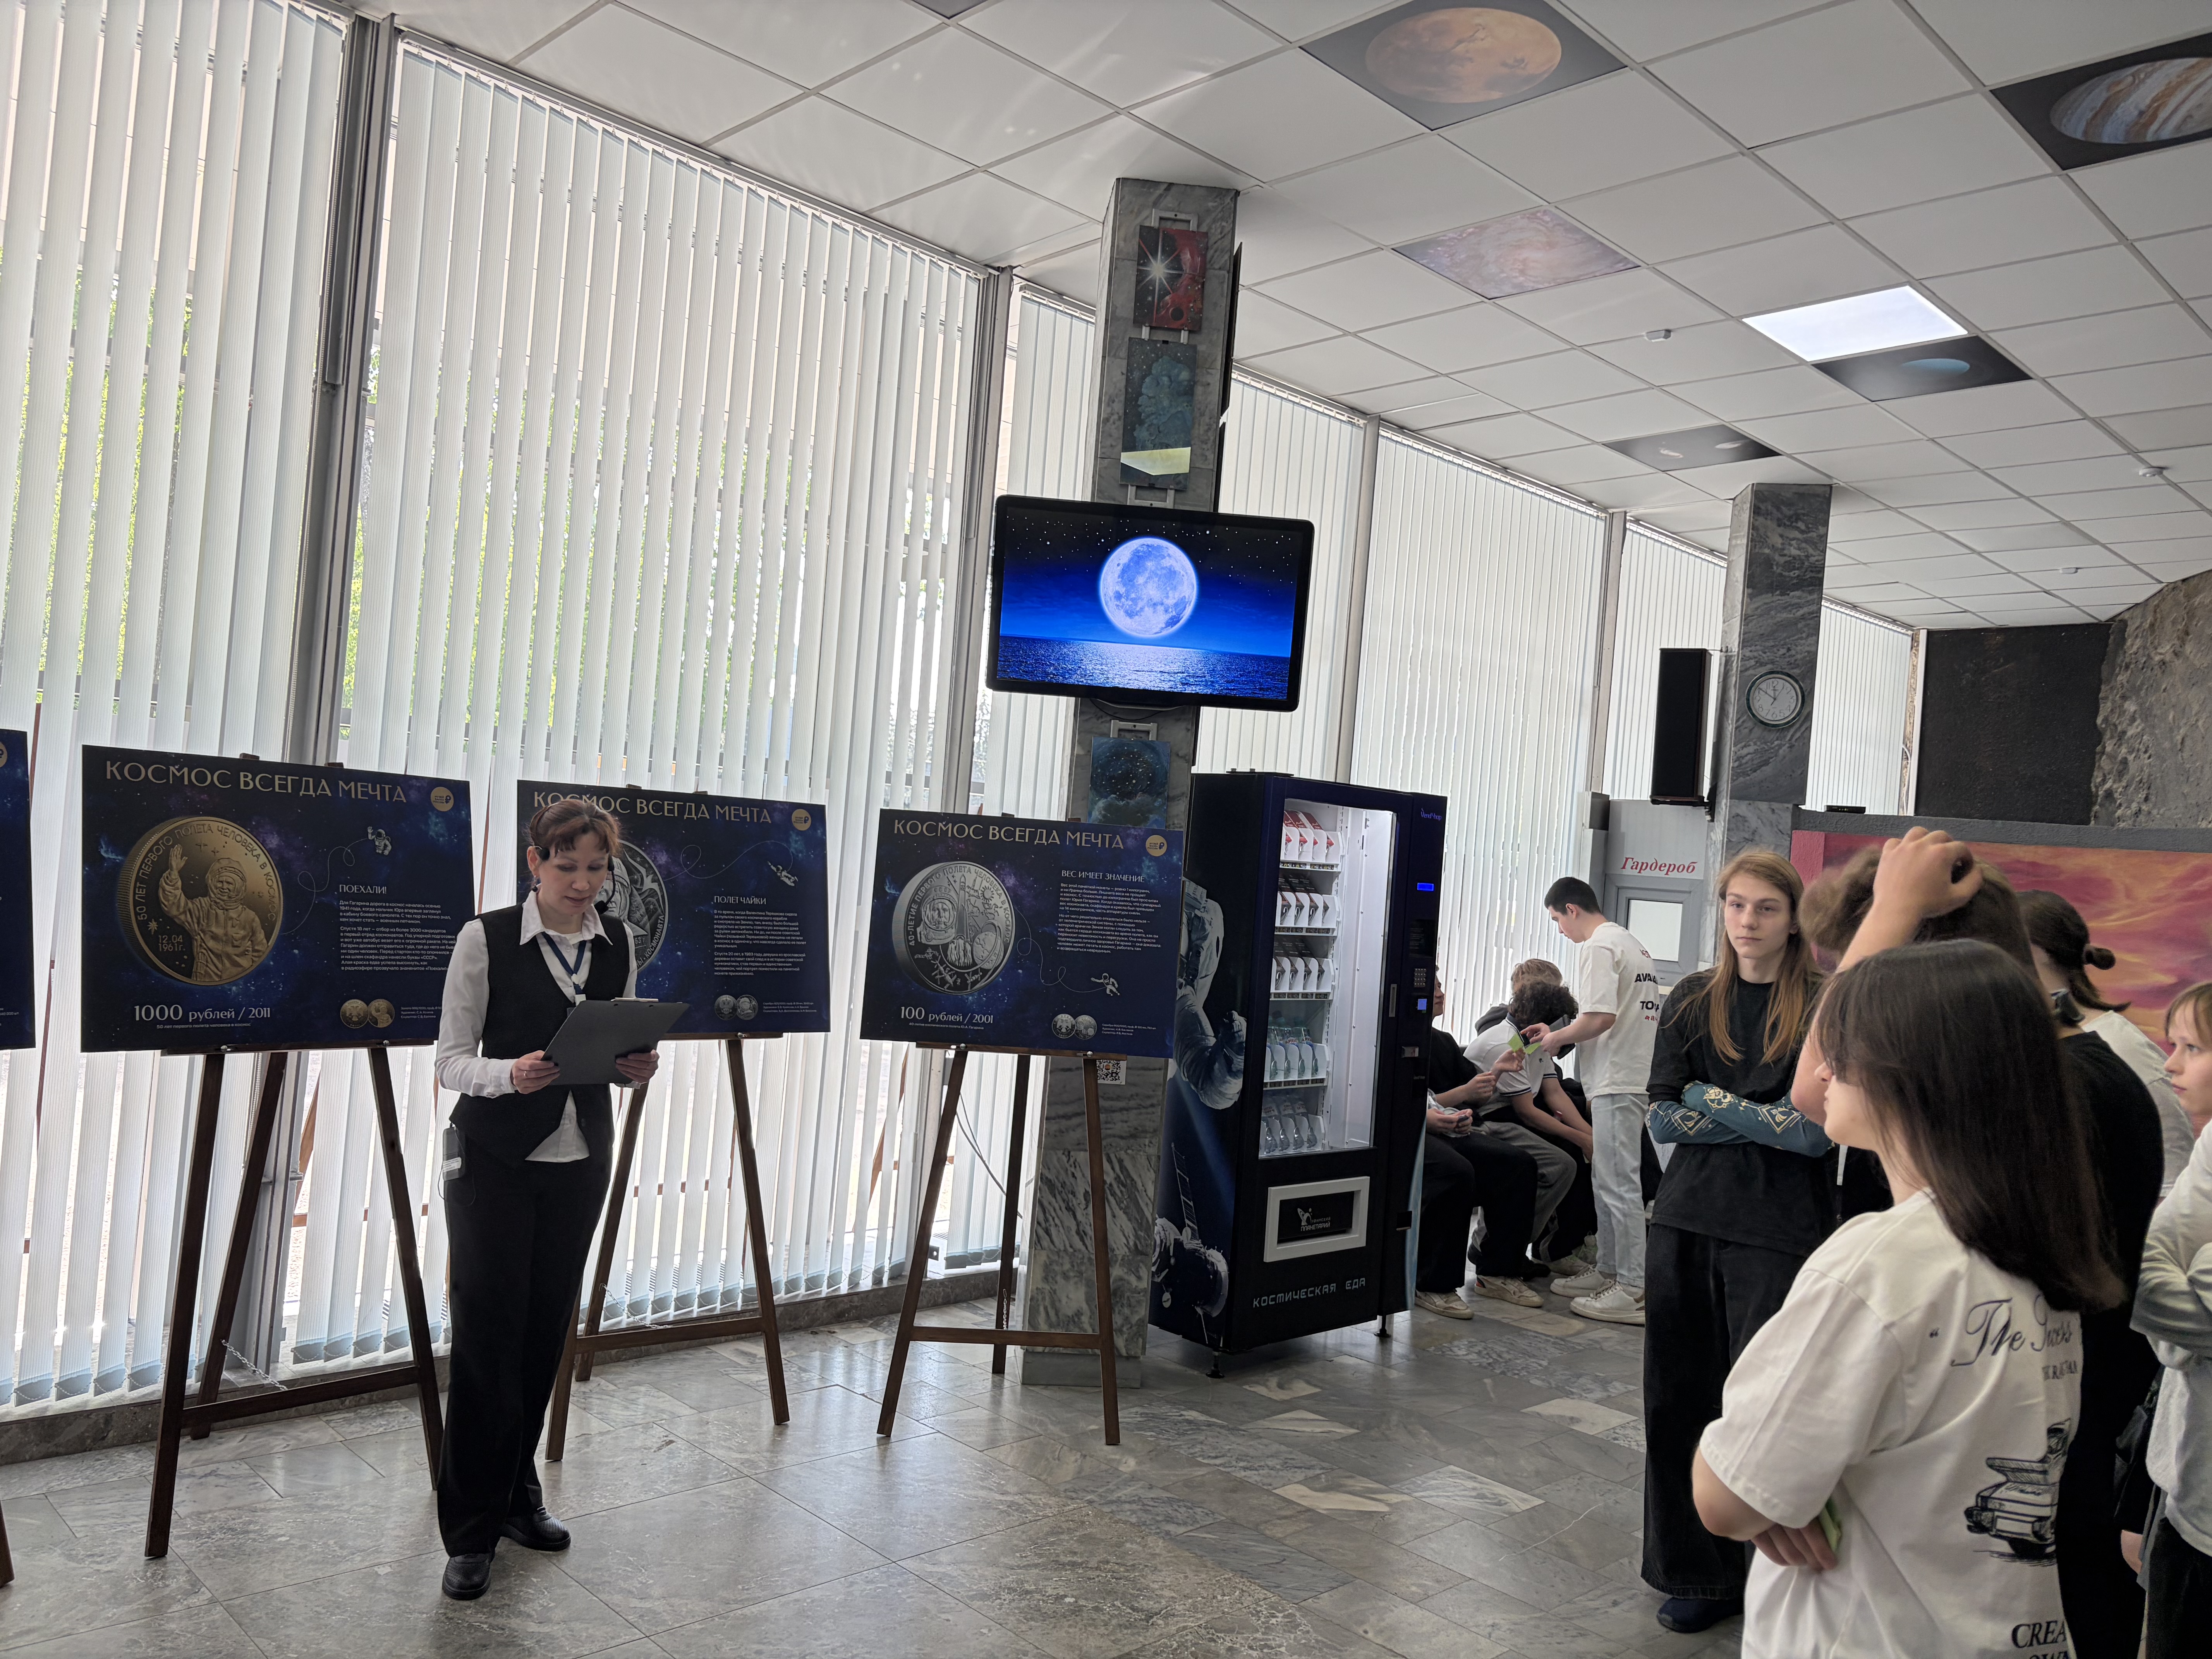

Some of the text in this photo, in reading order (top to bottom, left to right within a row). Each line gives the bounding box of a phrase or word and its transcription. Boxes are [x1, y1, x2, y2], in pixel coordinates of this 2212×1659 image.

[106, 760, 407, 803] КОСМОС ВСЕГДА МЕЧТА
[637, 799, 709, 820] ВСЕГДА
[716, 804, 771, 824] МЕЧТА
[175, 823, 213, 839] ПОЛЕТА
[894, 819, 1123, 849] КОСМОС ВСЕГДА МЕЧТА
[217, 825, 261, 862] ЧЕЛОВЕКА
[139, 835, 173, 879] ПЕРВОГО
[1620, 857, 1698, 876] Гардероб
[1079, 871, 1103, 879] ИМЕЕТ
[1105, 873, 1145, 883] ЗНАЧЕНИЕ
[136, 881, 146, 903] ЛЕТ
[264, 872, 277, 921] КОСМОС
[339, 884, 386, 894] ПОЕХАЛИ!
[740, 896, 766, 905] ЧАЙКИ
[907, 903, 919, 946] 40-ЛЕТИЕ
[914, 872, 942, 902] ПЕРВОГО
[943, 866, 972, 876] ПОЛЕТА
[974, 868, 1003, 899] ЧЕЛОВЕКА
[1003, 907, 1012, 943] КОСМОС
[137, 905, 147, 921] 50
[158, 935, 183, 943] 12.04
[158, 943, 185, 951] 1961г.
[644, 915, 665, 959] КОСМОНАВТА
[134, 1005, 182, 1021] 1000
[189, 1008, 235, 1022] рублей
[249, 1007, 270, 1018] 2011
[901, 1006, 925, 1020] 100
[929, 1012, 962, 1022] рублей
[972, 1014, 993, 1024] 2001
[1301, 1221, 1330, 1231] ПЛАНЕТАРИЙ
[1253, 1278, 1365, 1308] КОСМИЧЕСКАЯ ЕДА
[1950, 1297, 2026, 1367] The
